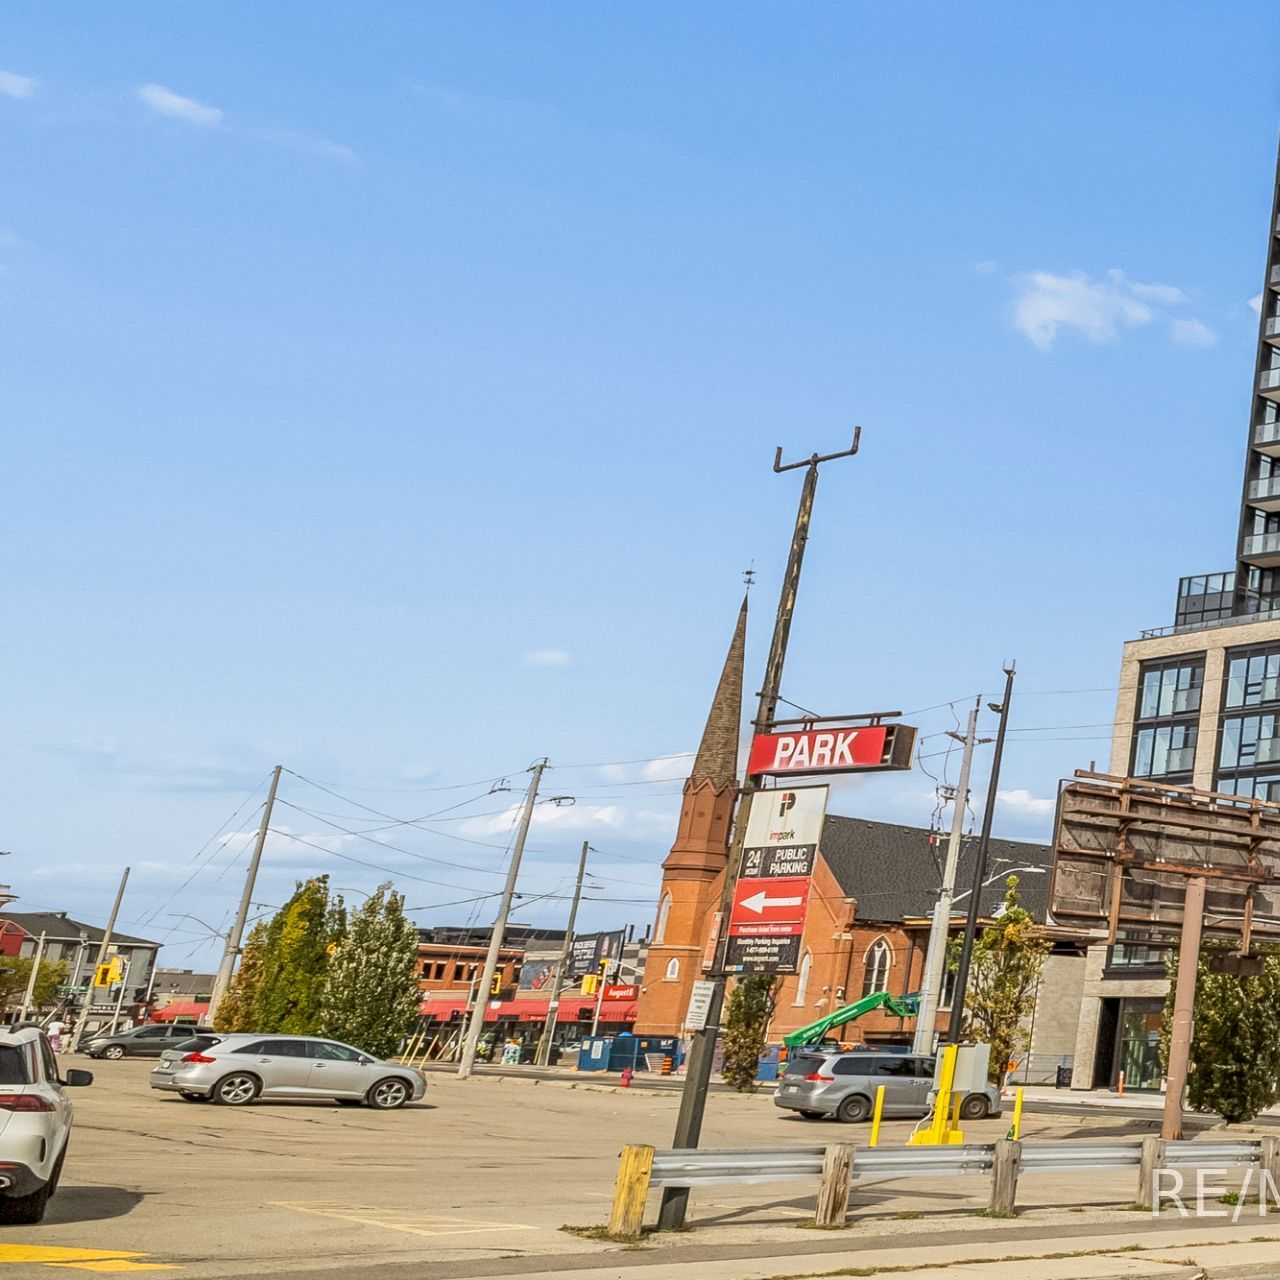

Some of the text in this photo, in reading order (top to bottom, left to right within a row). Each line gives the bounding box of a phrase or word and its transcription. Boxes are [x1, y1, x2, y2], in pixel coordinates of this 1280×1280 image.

[772, 731, 859, 769] PARK
[769, 829, 795, 843] impark
[746, 850, 761, 867] 24
[775, 848, 807, 861] PUBLIC
[770, 862, 808, 874] PARKING
